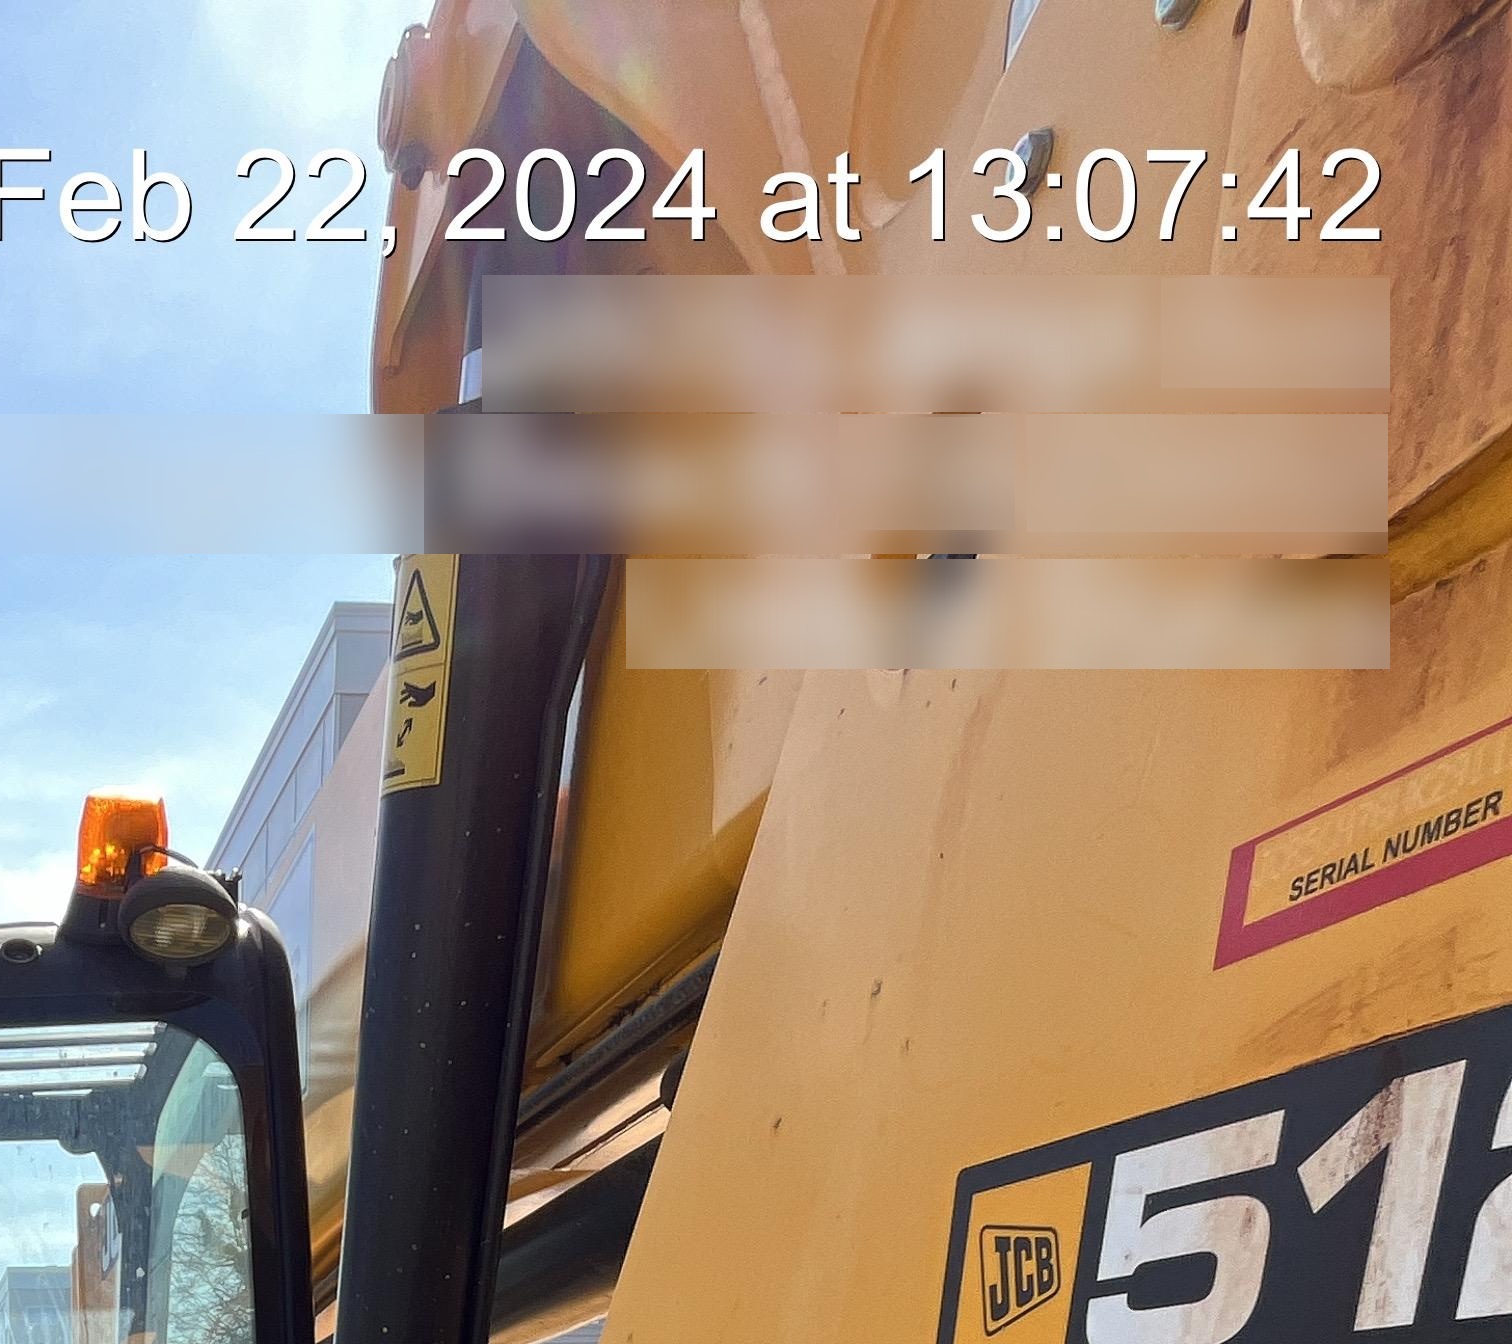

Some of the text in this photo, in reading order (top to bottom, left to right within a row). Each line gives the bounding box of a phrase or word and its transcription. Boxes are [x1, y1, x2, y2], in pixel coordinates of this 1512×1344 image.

[1289, 848, 1375, 901] SERIAL
[1382, 790, 1503, 863] NUMBER
[989, 1235, 1055, 1321] JCB
